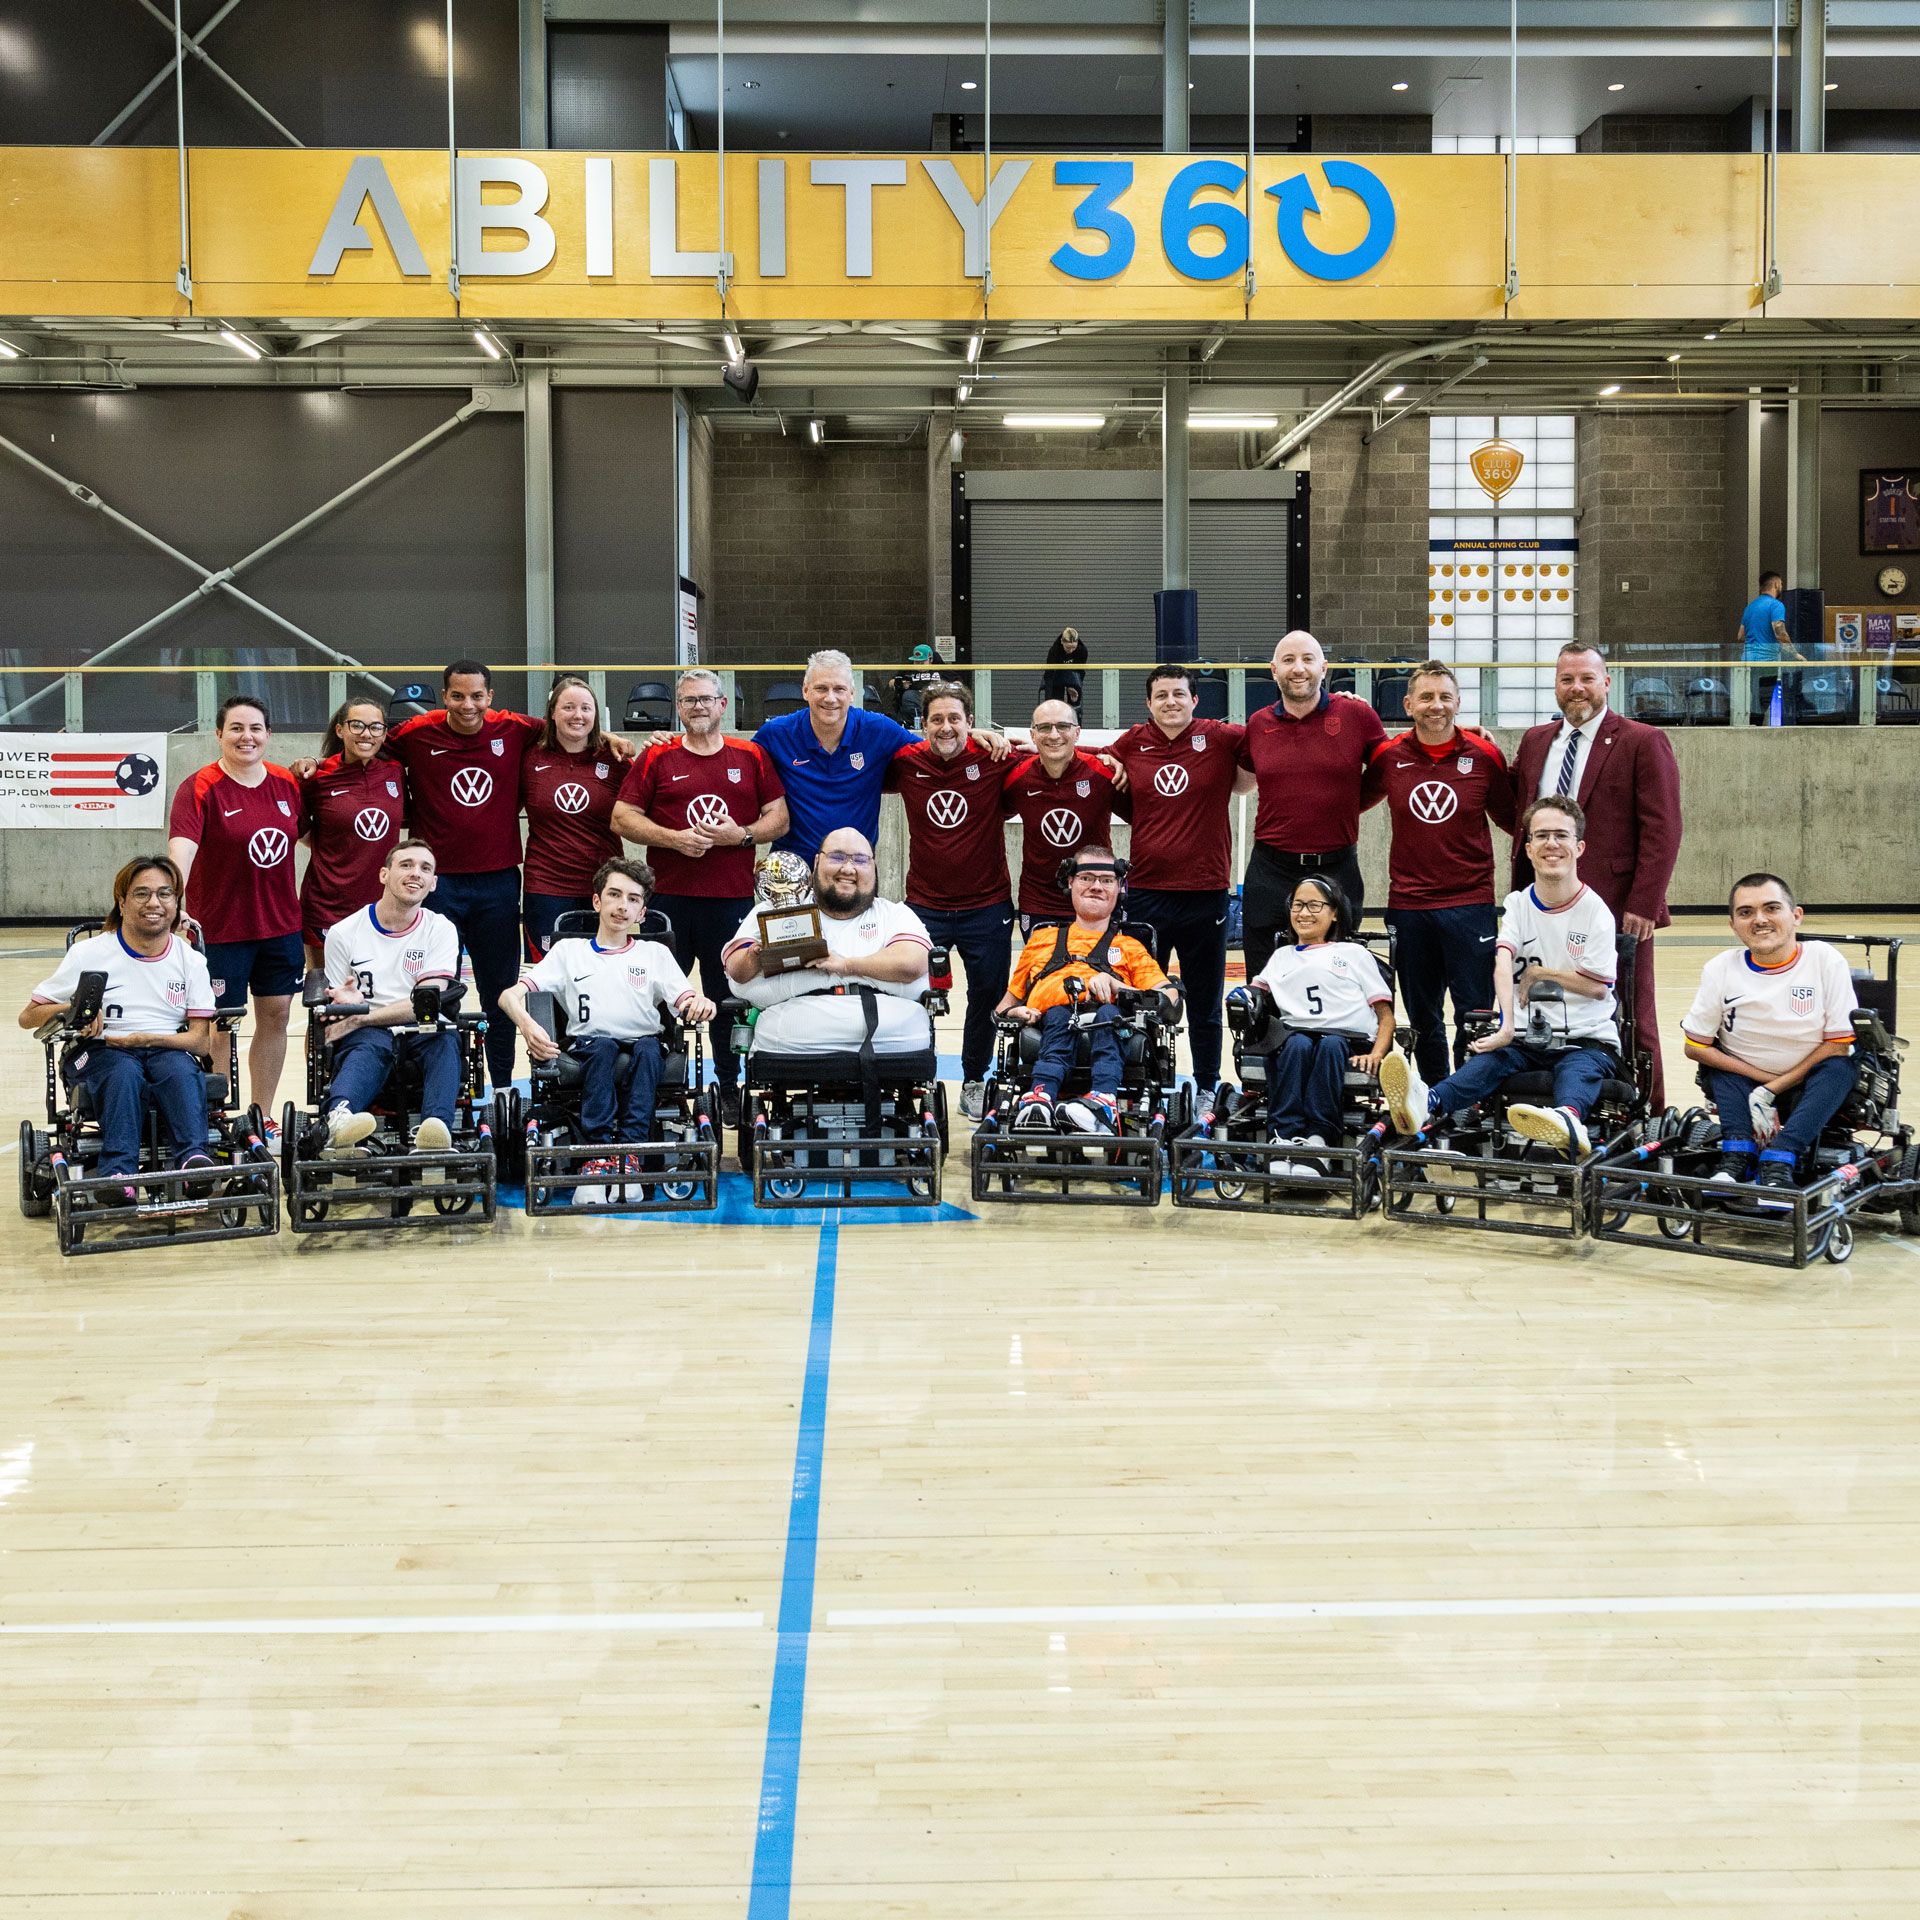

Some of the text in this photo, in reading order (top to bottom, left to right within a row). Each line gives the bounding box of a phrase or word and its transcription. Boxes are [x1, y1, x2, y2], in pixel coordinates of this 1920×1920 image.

[1482, 460, 1511, 469] CLUB
[1484, 469, 1512, 480] 360
[1453, 541, 1540, 549] ANNUAL GIVING CLUB
[1868, 619, 1891, 631] MAX
[1192, 735, 1205, 744] USA
[850, 753, 863, 762] USA
[1459, 757, 1472, 766] USA
[966, 765, 979, 773] USA
[1076, 780, 1089, 788] USA
[860, 922, 877, 931] USA
[1569, 932, 1587, 944] USA
[405, 950, 424, 962] USA
[1333, 959, 1347, 968] USA
[629, 966, 646, 977] USA
[168, 981, 186, 993] USA
[1791, 988, 1813, 1000] USA
[1306, 985, 1323, 1015] 5
[578, 993, 590, 1023] 6
